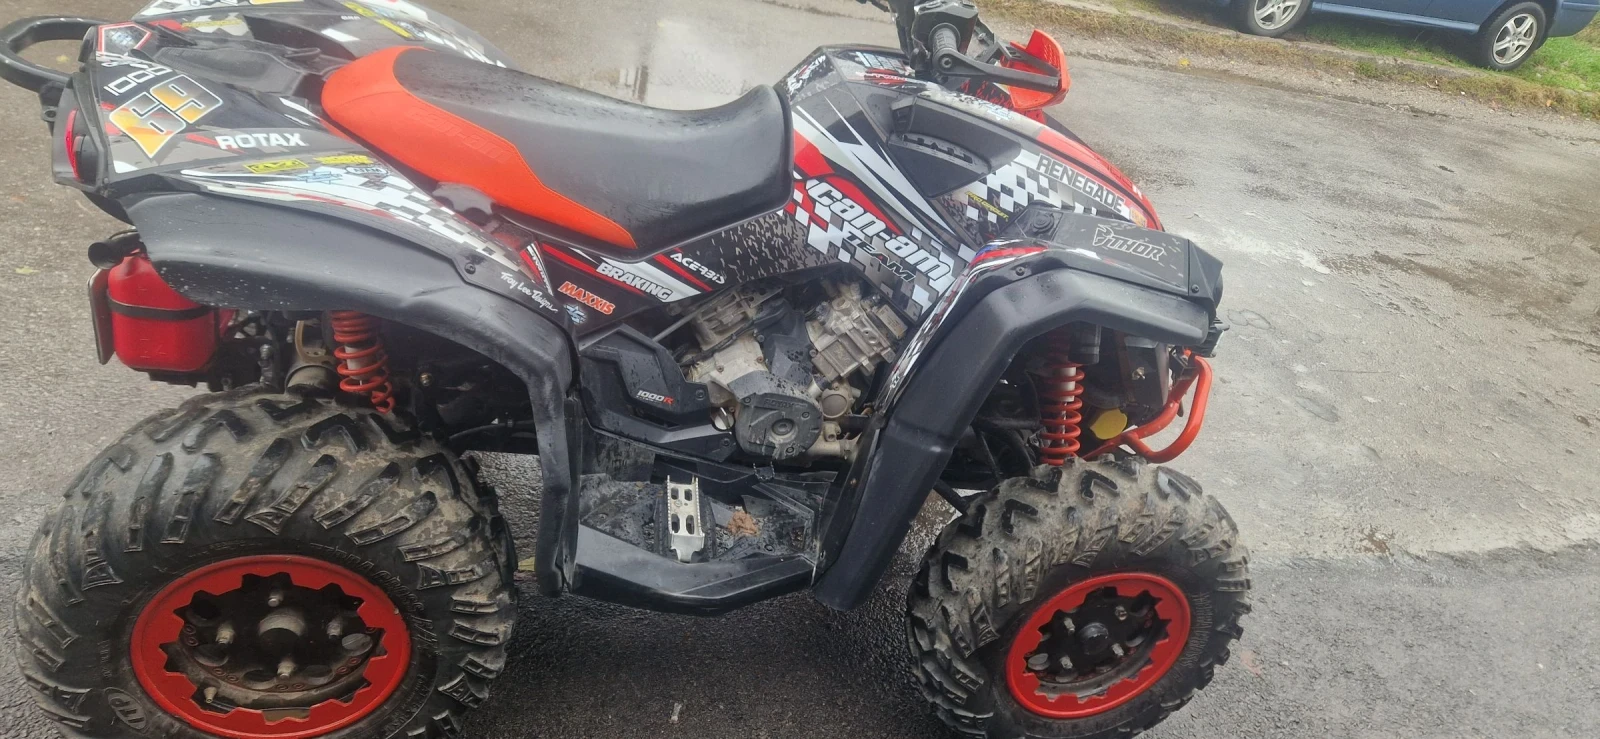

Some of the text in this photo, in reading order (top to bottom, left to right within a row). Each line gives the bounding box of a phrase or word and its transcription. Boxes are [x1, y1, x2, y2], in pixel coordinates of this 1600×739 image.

[109, 74, 224, 158] 69
[214, 132, 305, 150] ROTAX
[1036, 153, 1126, 214] RENEGADE
[1106, 233, 1165, 262] THOR
[500, 271, 518, 290] Troy
[517, 282, 532, 296] Lee
[596, 261, 673, 301] BRAKING
[670, 252, 725, 285] ACERBIS
[558, 280, 616, 315] MAXXIS
